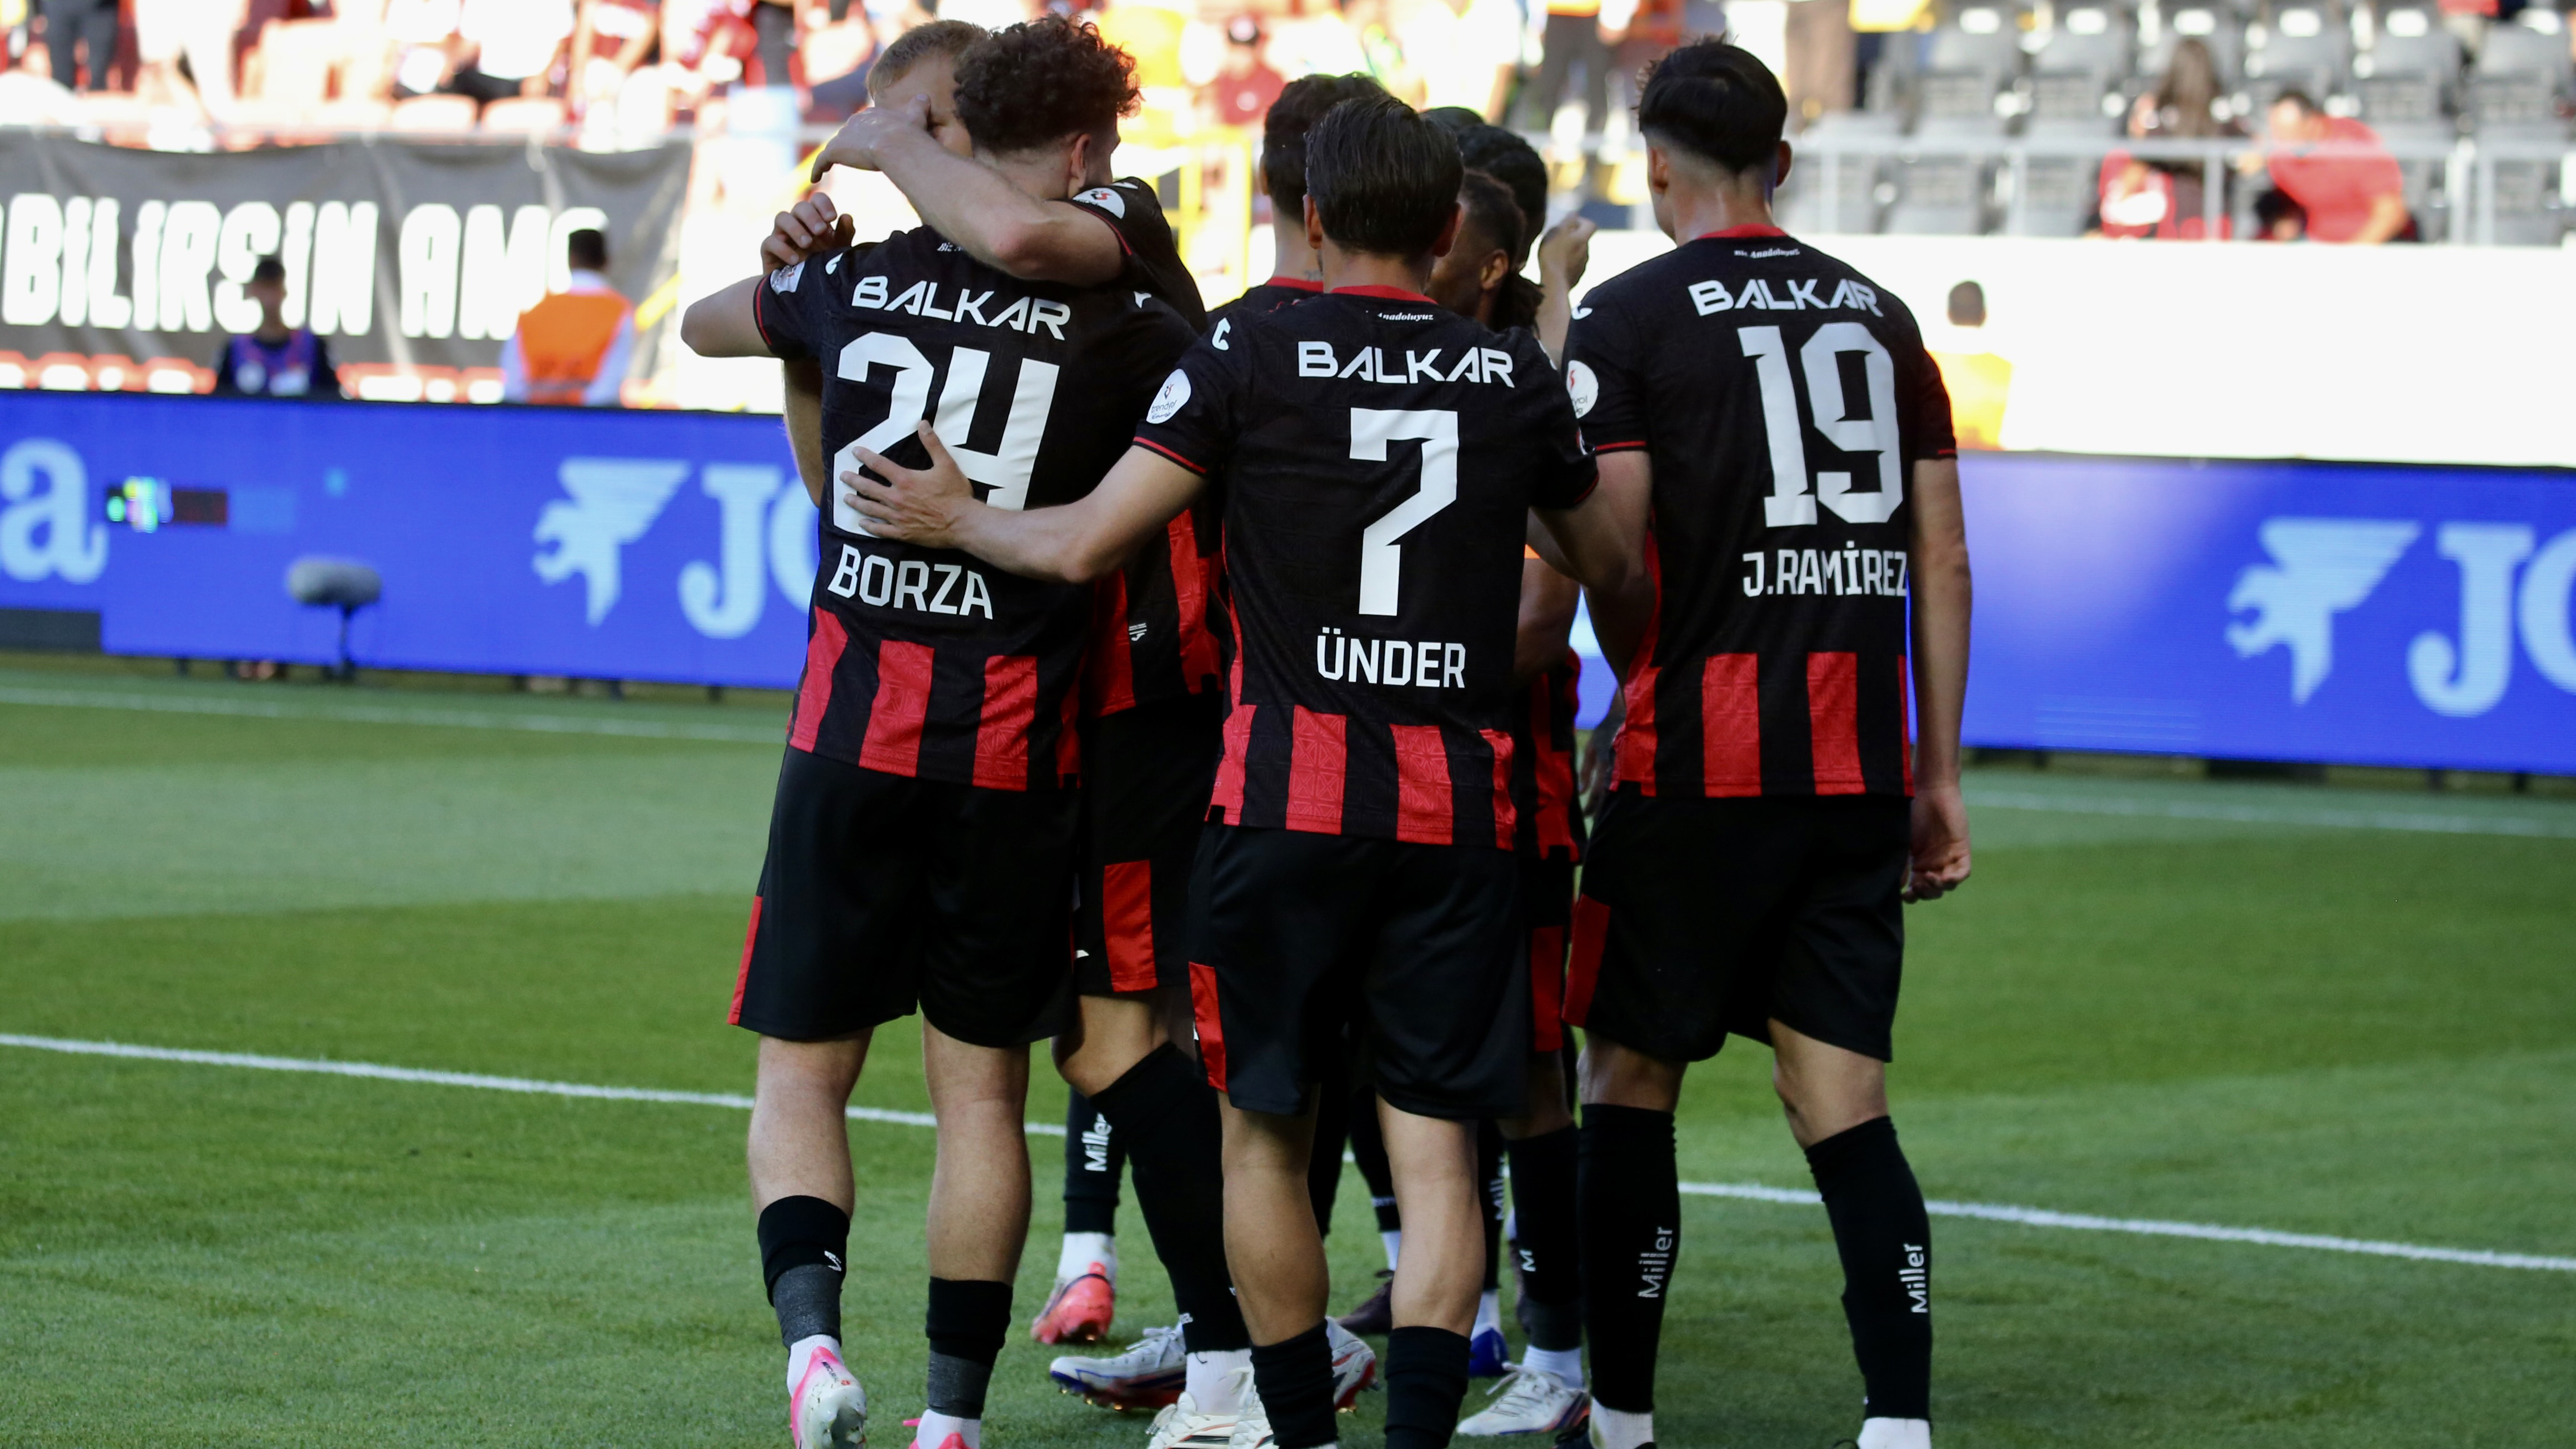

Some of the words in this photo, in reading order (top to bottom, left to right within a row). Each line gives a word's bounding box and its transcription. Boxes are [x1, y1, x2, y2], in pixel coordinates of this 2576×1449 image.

[851, 276, 1071, 341] BALKAR
[1688, 278, 1884, 317] BALKAR
[1298, 341, 1515, 388] BALKAR
[833, 331, 1060, 537] 24
[1737, 322, 1903, 527] 19
[1349, 407, 1459, 616] 7
[827, 544, 993, 620] BORZA
[1317, 626, 1466, 688] ÜNDER
[1638, 1226, 1673, 1298] Miller
[1898, 1243, 1928, 1313] Miller
